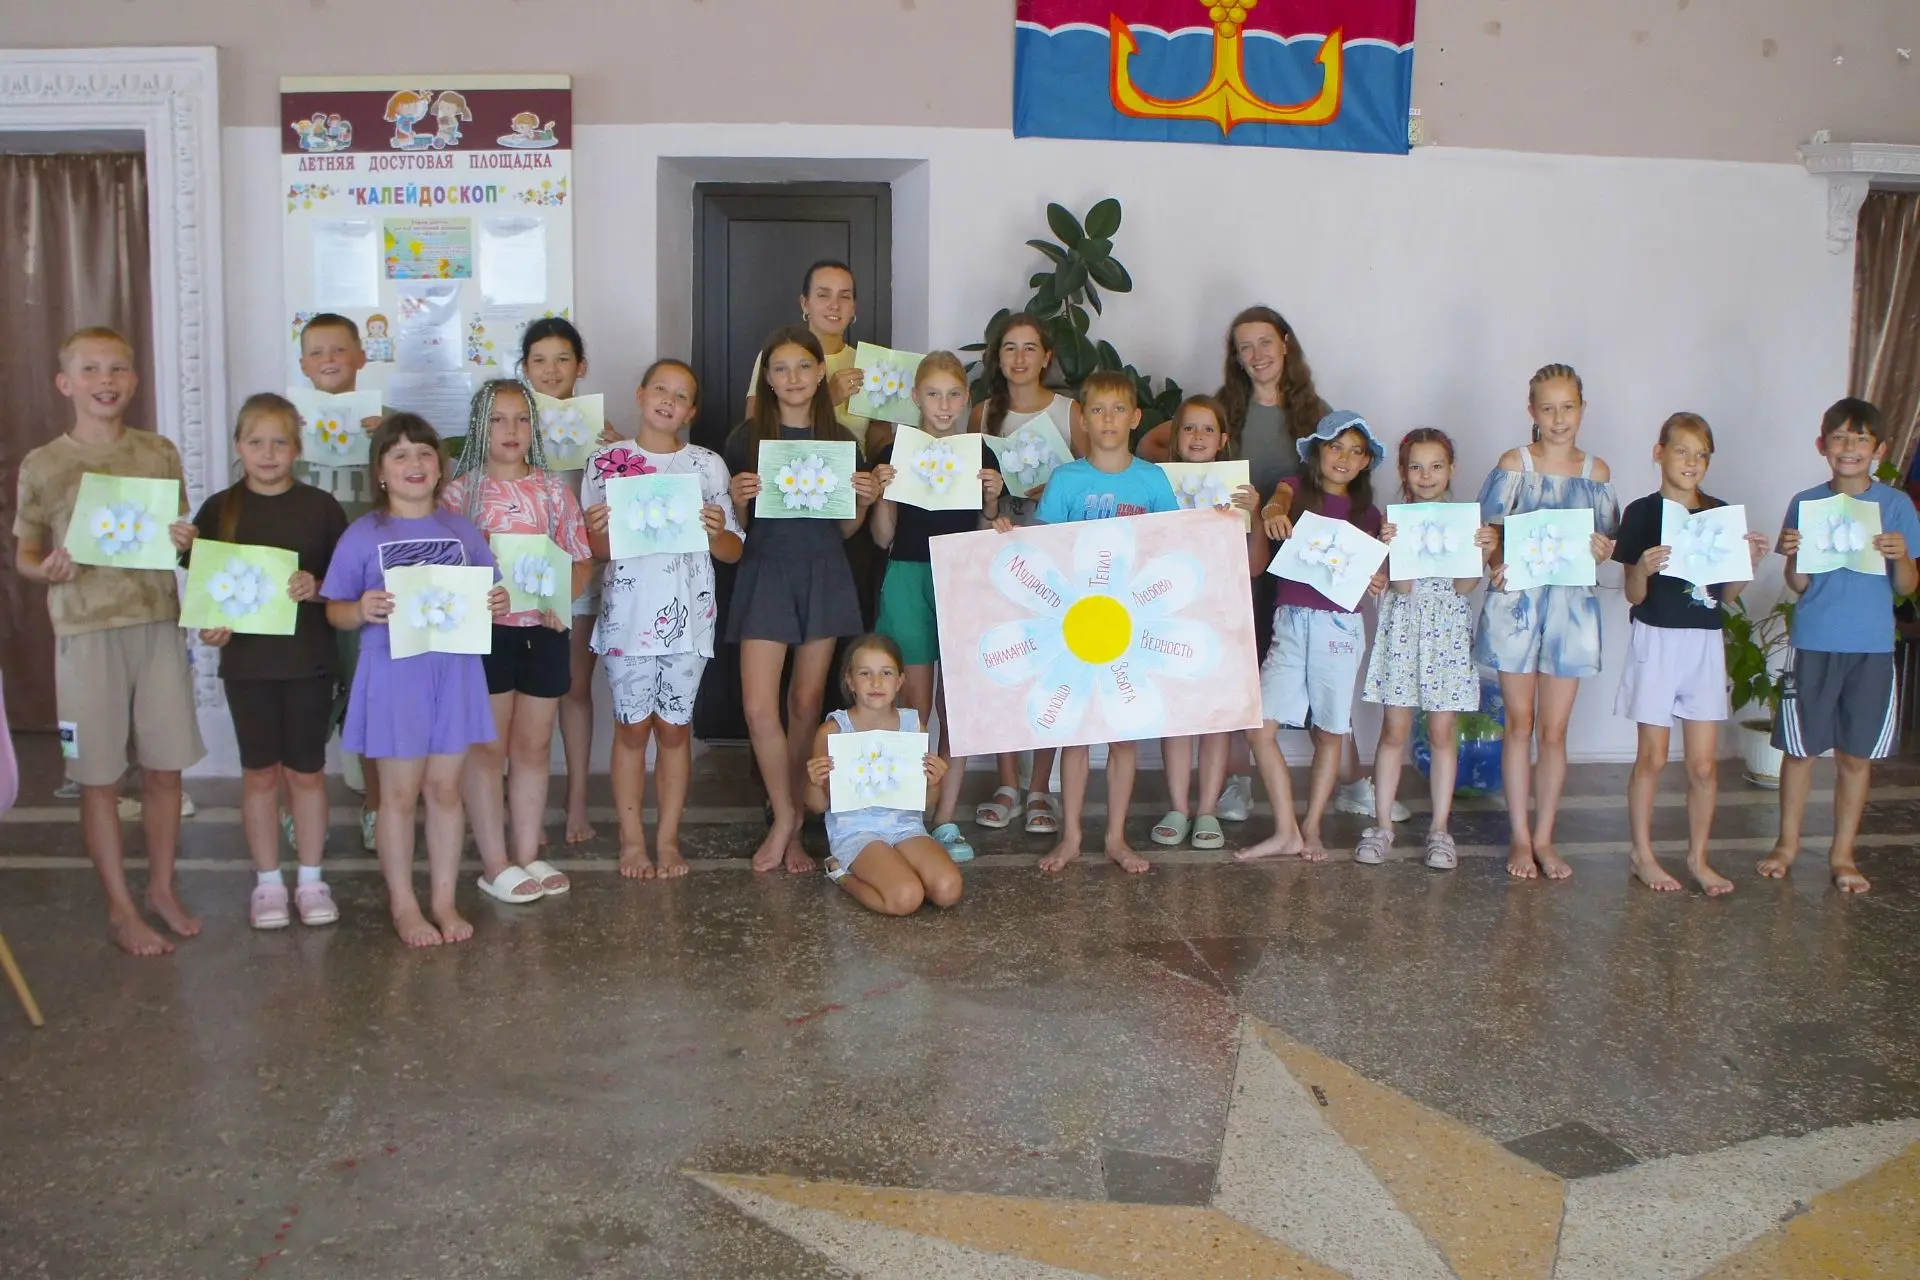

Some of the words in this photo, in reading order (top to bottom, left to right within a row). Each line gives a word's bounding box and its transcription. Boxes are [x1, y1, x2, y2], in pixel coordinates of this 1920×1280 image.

[299, 156, 355, 172] ЛЕТНЯЯ
[368, 154, 453, 172] ДОСУГОВАЯ
[469, 153, 552, 170] ПЛОЩАДКА
